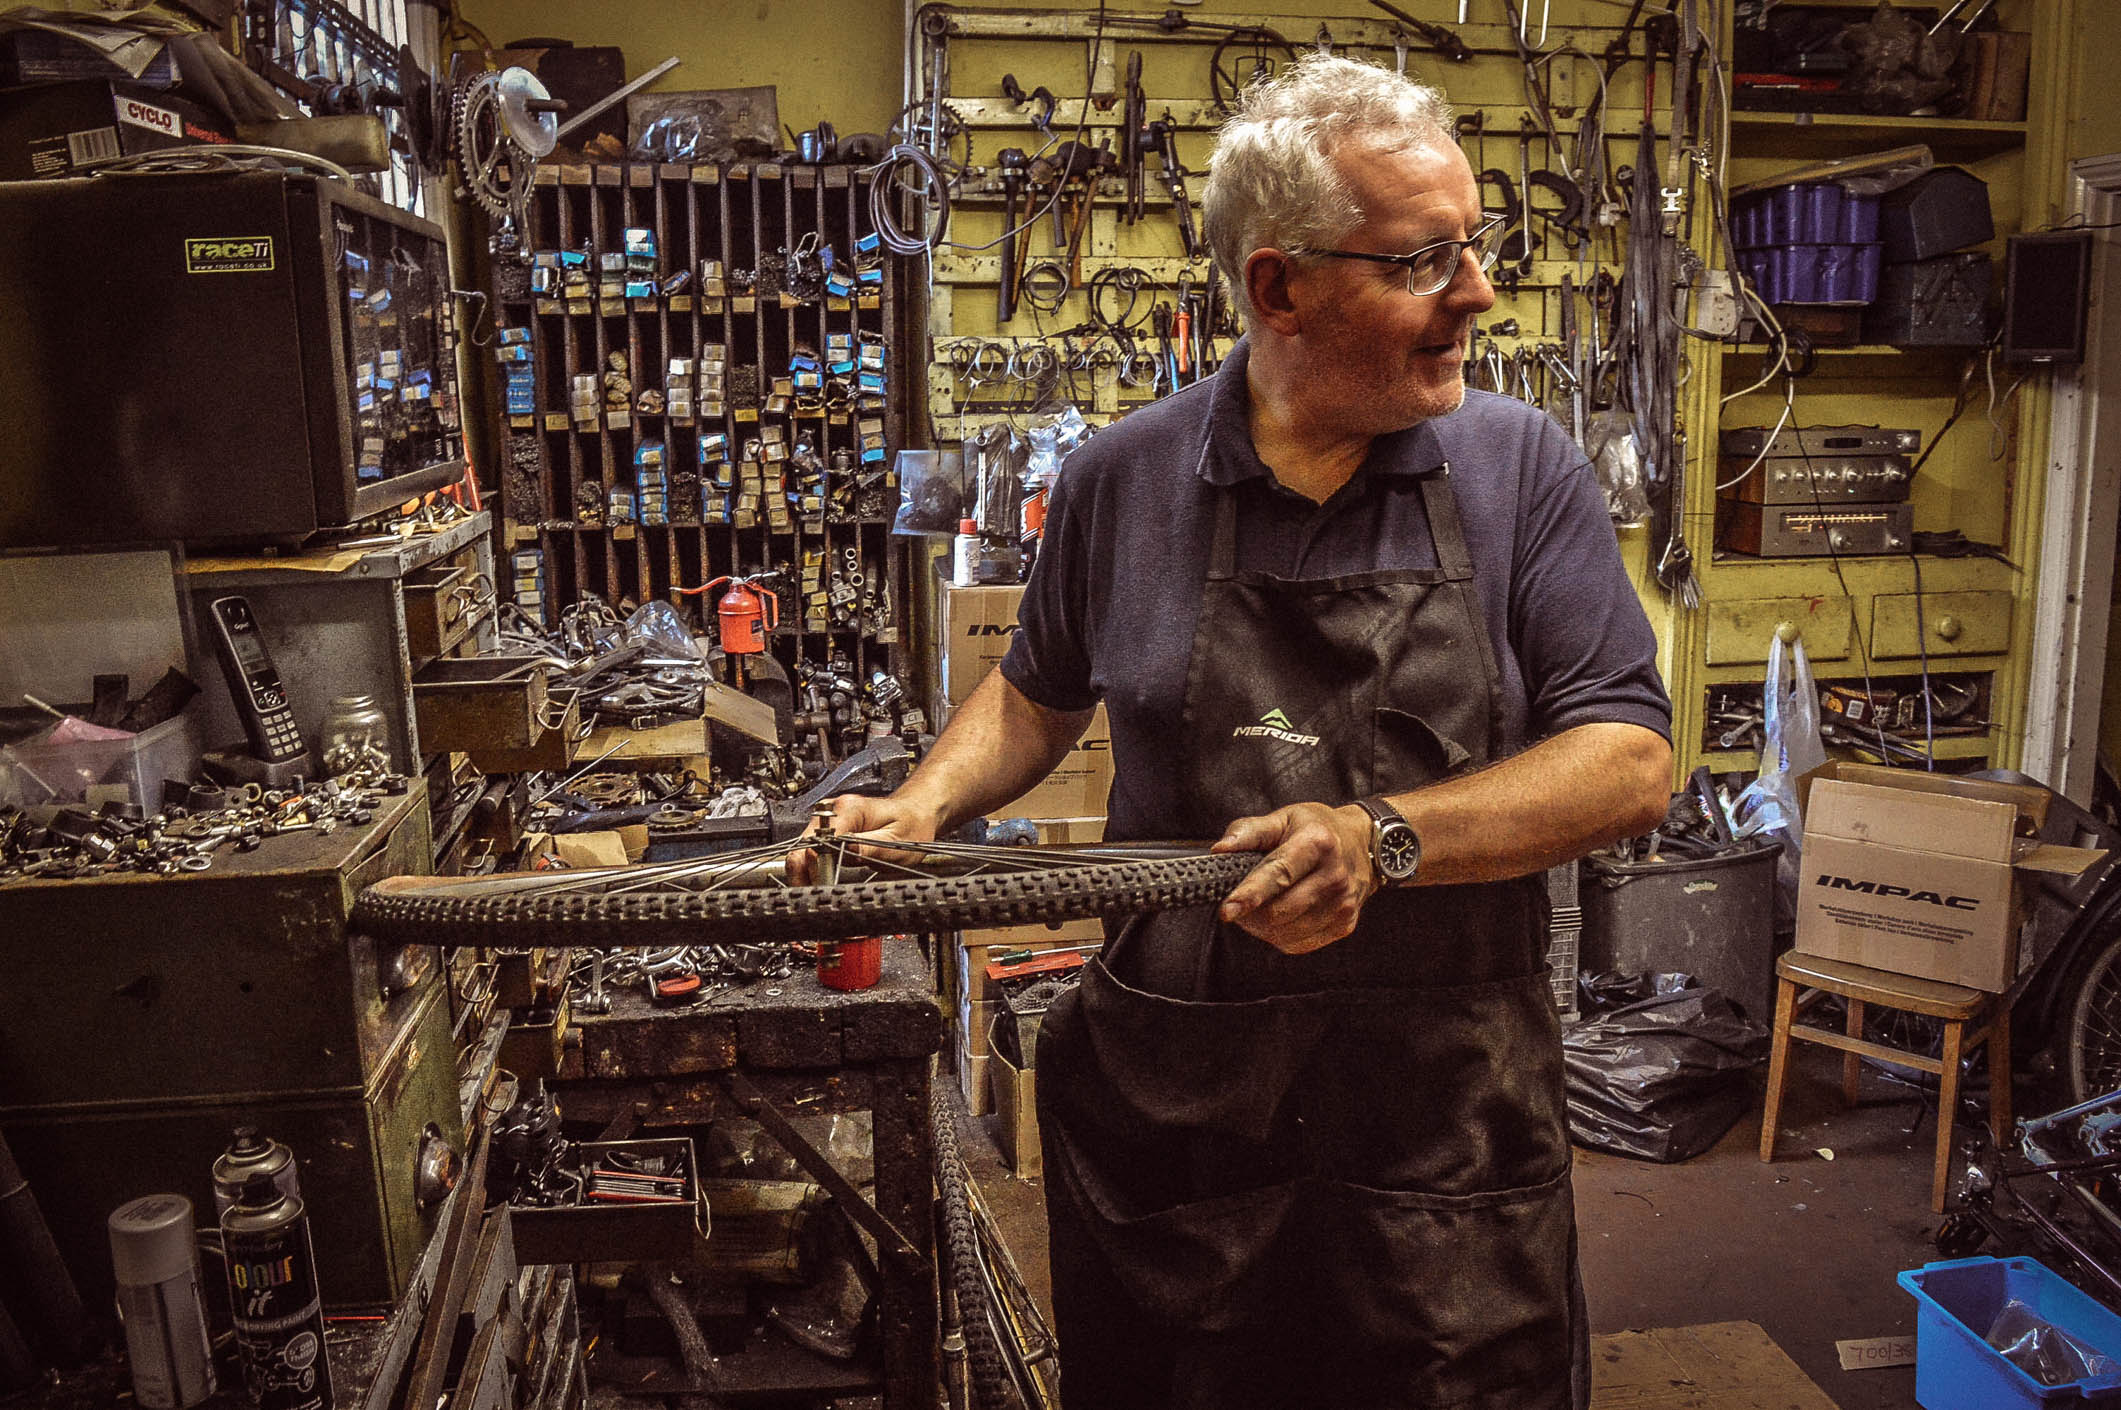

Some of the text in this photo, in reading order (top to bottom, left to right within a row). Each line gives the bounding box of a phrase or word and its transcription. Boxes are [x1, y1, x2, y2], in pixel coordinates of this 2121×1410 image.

[127, 102, 172, 129] CYCLO
[191, 242, 269, 258] raceTi
[1232, 726, 1320, 746] MERIDA
[1816, 874, 1981, 911] IMPAC
